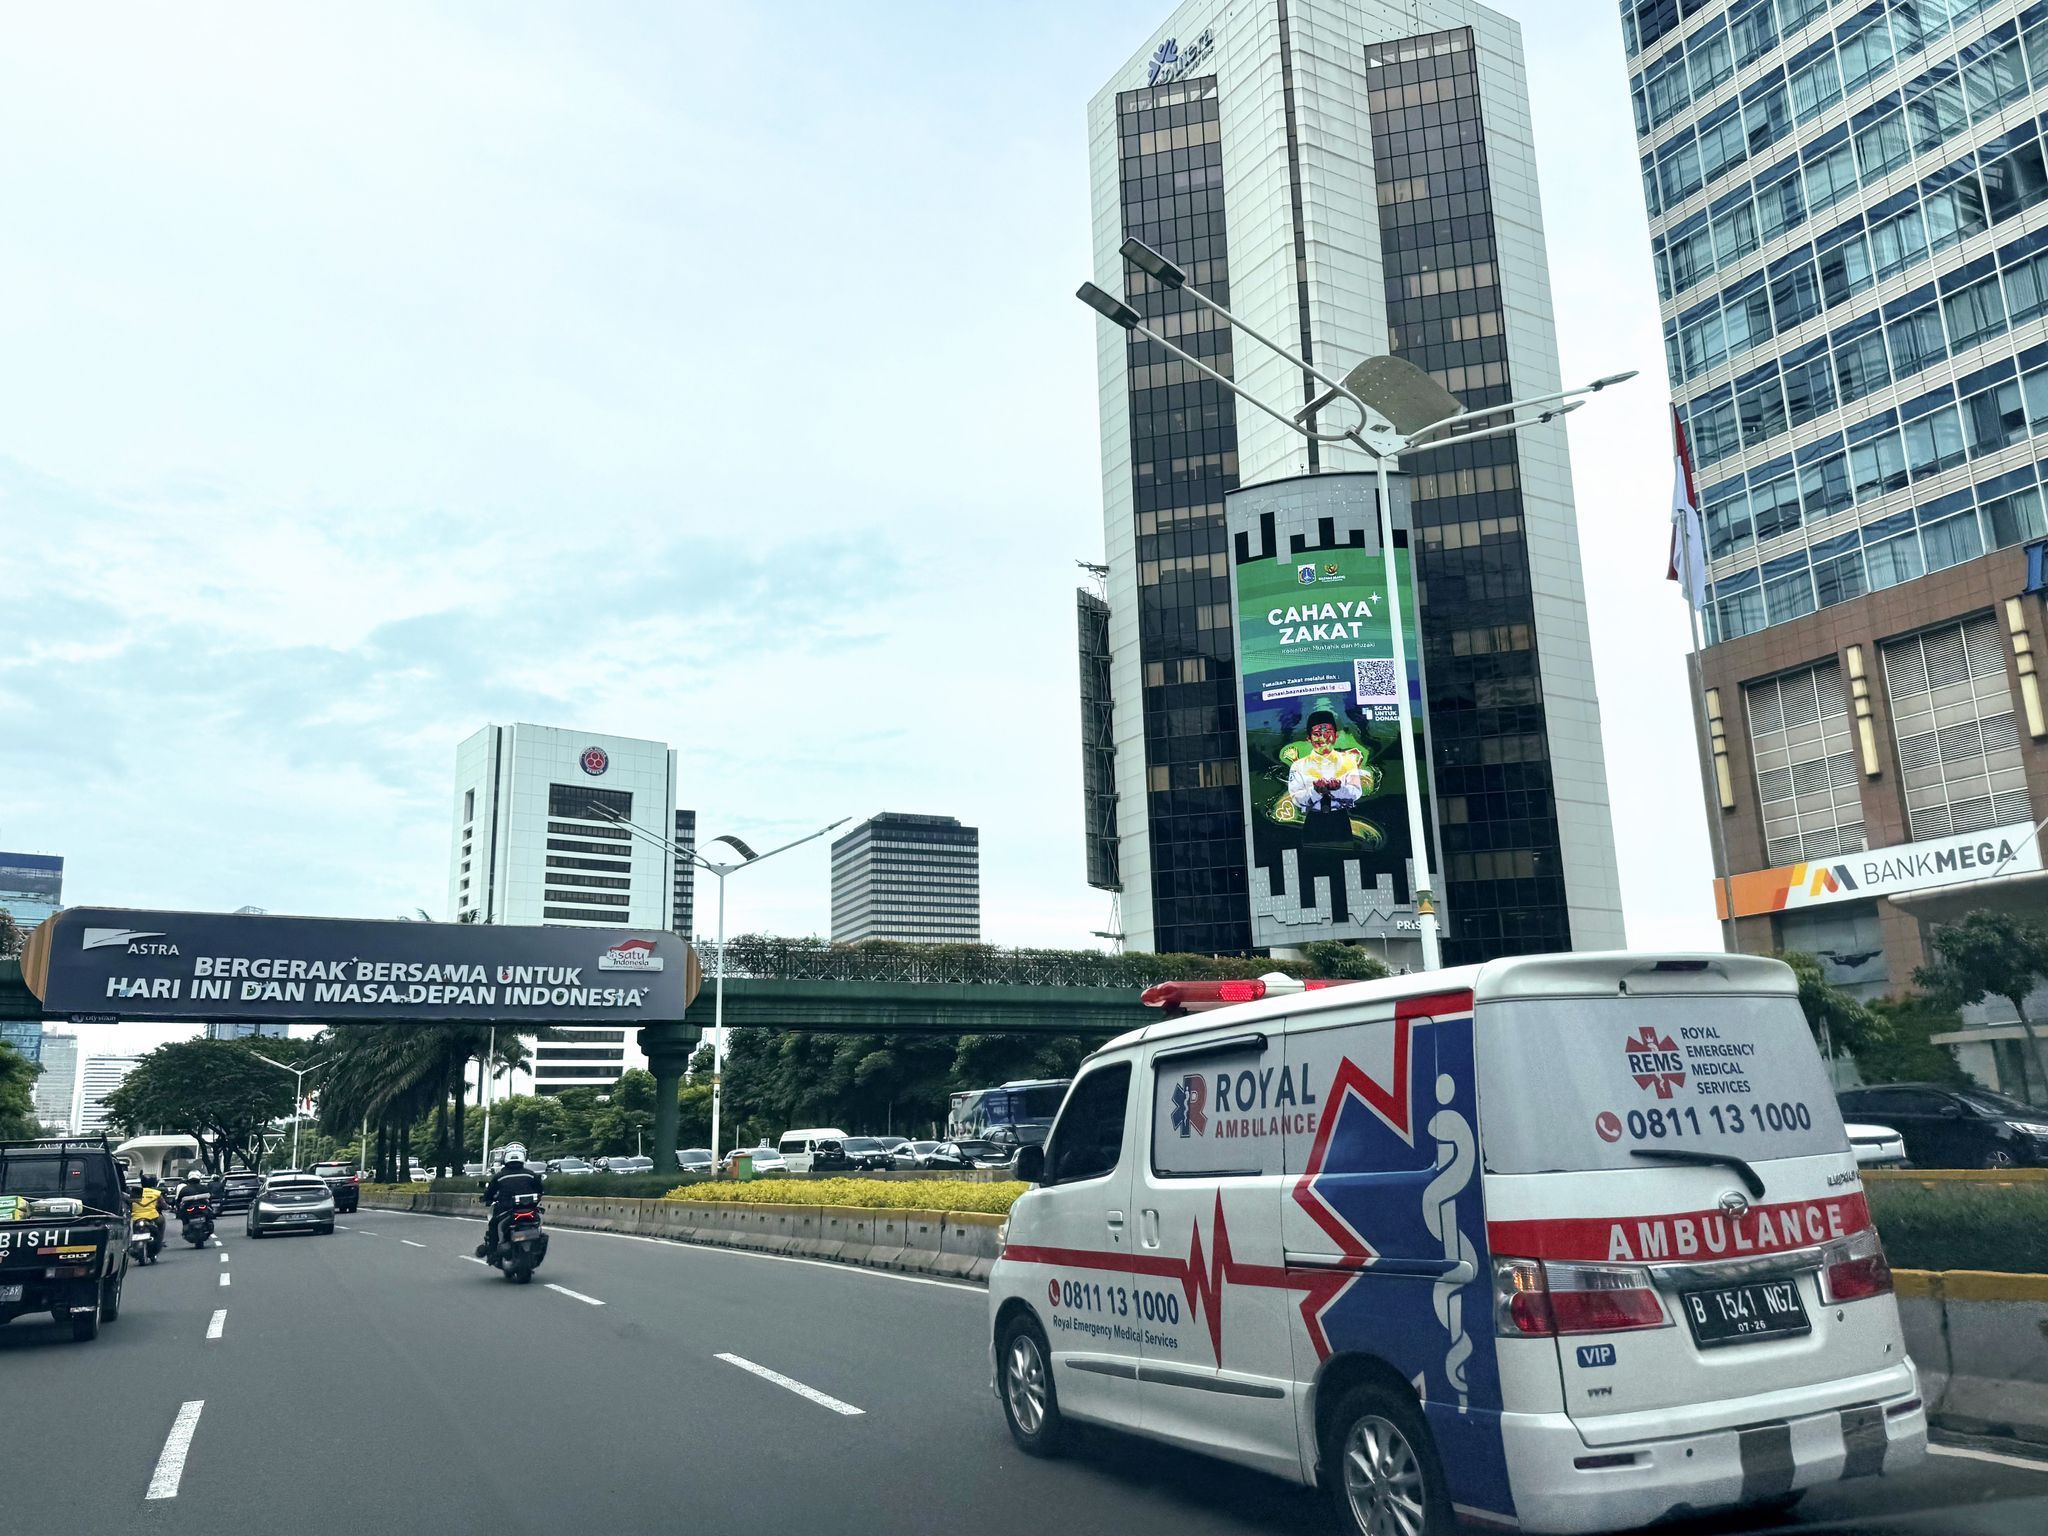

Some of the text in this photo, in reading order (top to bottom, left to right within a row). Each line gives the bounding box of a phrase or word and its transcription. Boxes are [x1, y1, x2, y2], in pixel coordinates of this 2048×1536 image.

[1267, 600, 1373, 626] CAHAYA
[1279, 621, 1363, 645] ZAKAT
[127, 943, 180, 956] ASTRA
[619, 950, 645, 961] satu
[194, 956, 582, 986] BERGERAK BERSAMA UNTUK
[106, 977, 643, 1008] HARI INI DAN MASA DEPAN INDONESIA
[1680, 1026, 1720, 1040] ROYAL
[1627, 1052, 1684, 1074] REMS
[1685, 1043, 1755, 1058] EMERGENCY
[1691, 1062, 1744, 1076] MEDICAL
[1215, 1062, 1316, 1112] ROYAL
[1696, 1080, 1751, 1095] SERVICES
[1215, 1112, 1317, 1139] AMBULANCE
[1627, 1102, 1812, 1140] 0811 13 1000
[1607, 1203, 1846, 1262] AMBULANCE
[1063, 1279, 1179, 1325] 0811 13 1000
[1691, 1284, 1800, 1324] B 1541 NGZ
[1053, 1314, 1179, 1349] Royal Emergency Medical Services
[1582, 1346, 1611, 1364] VIP
